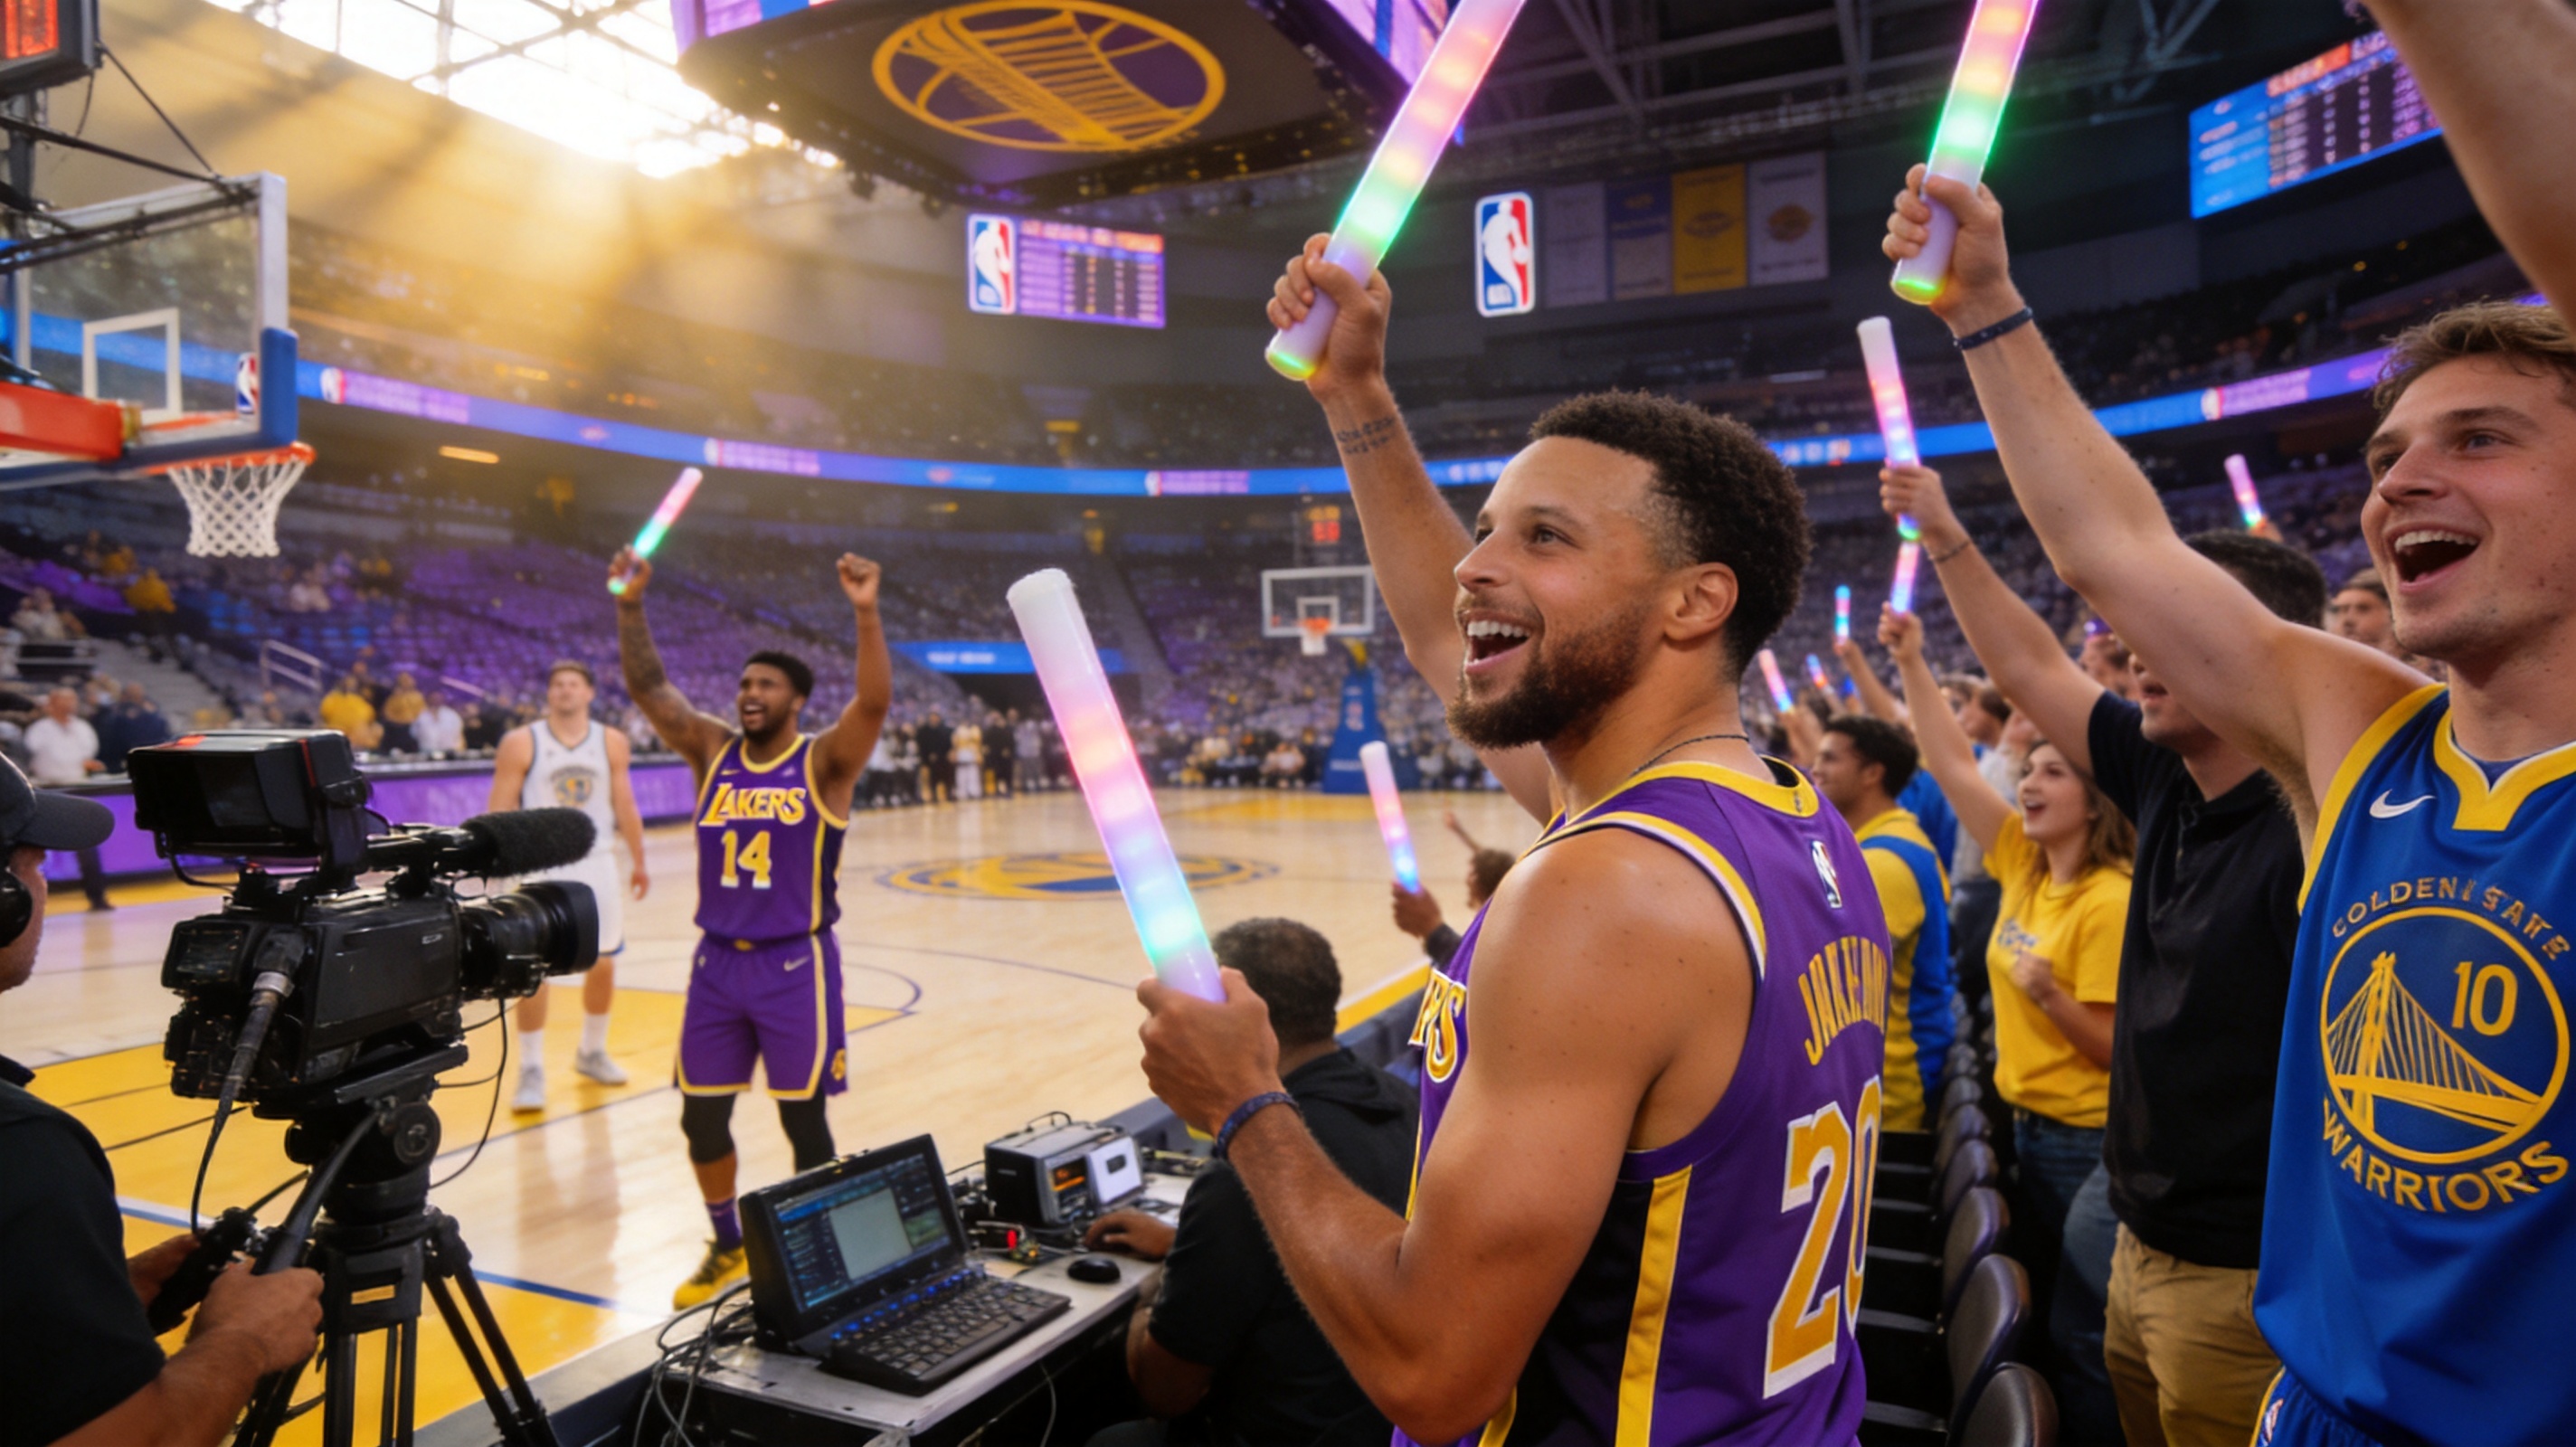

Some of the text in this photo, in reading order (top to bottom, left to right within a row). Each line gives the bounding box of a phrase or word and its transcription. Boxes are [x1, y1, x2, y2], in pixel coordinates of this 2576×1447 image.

[698, 782, 807, 827] LAKERS
[720, 829, 772, 889] 14
[2451, 960, 2517, 1036] 10
[2323, 1092, 2569, 1213] WARRIORS
[1763, 1073, 1882, 1400] 20
